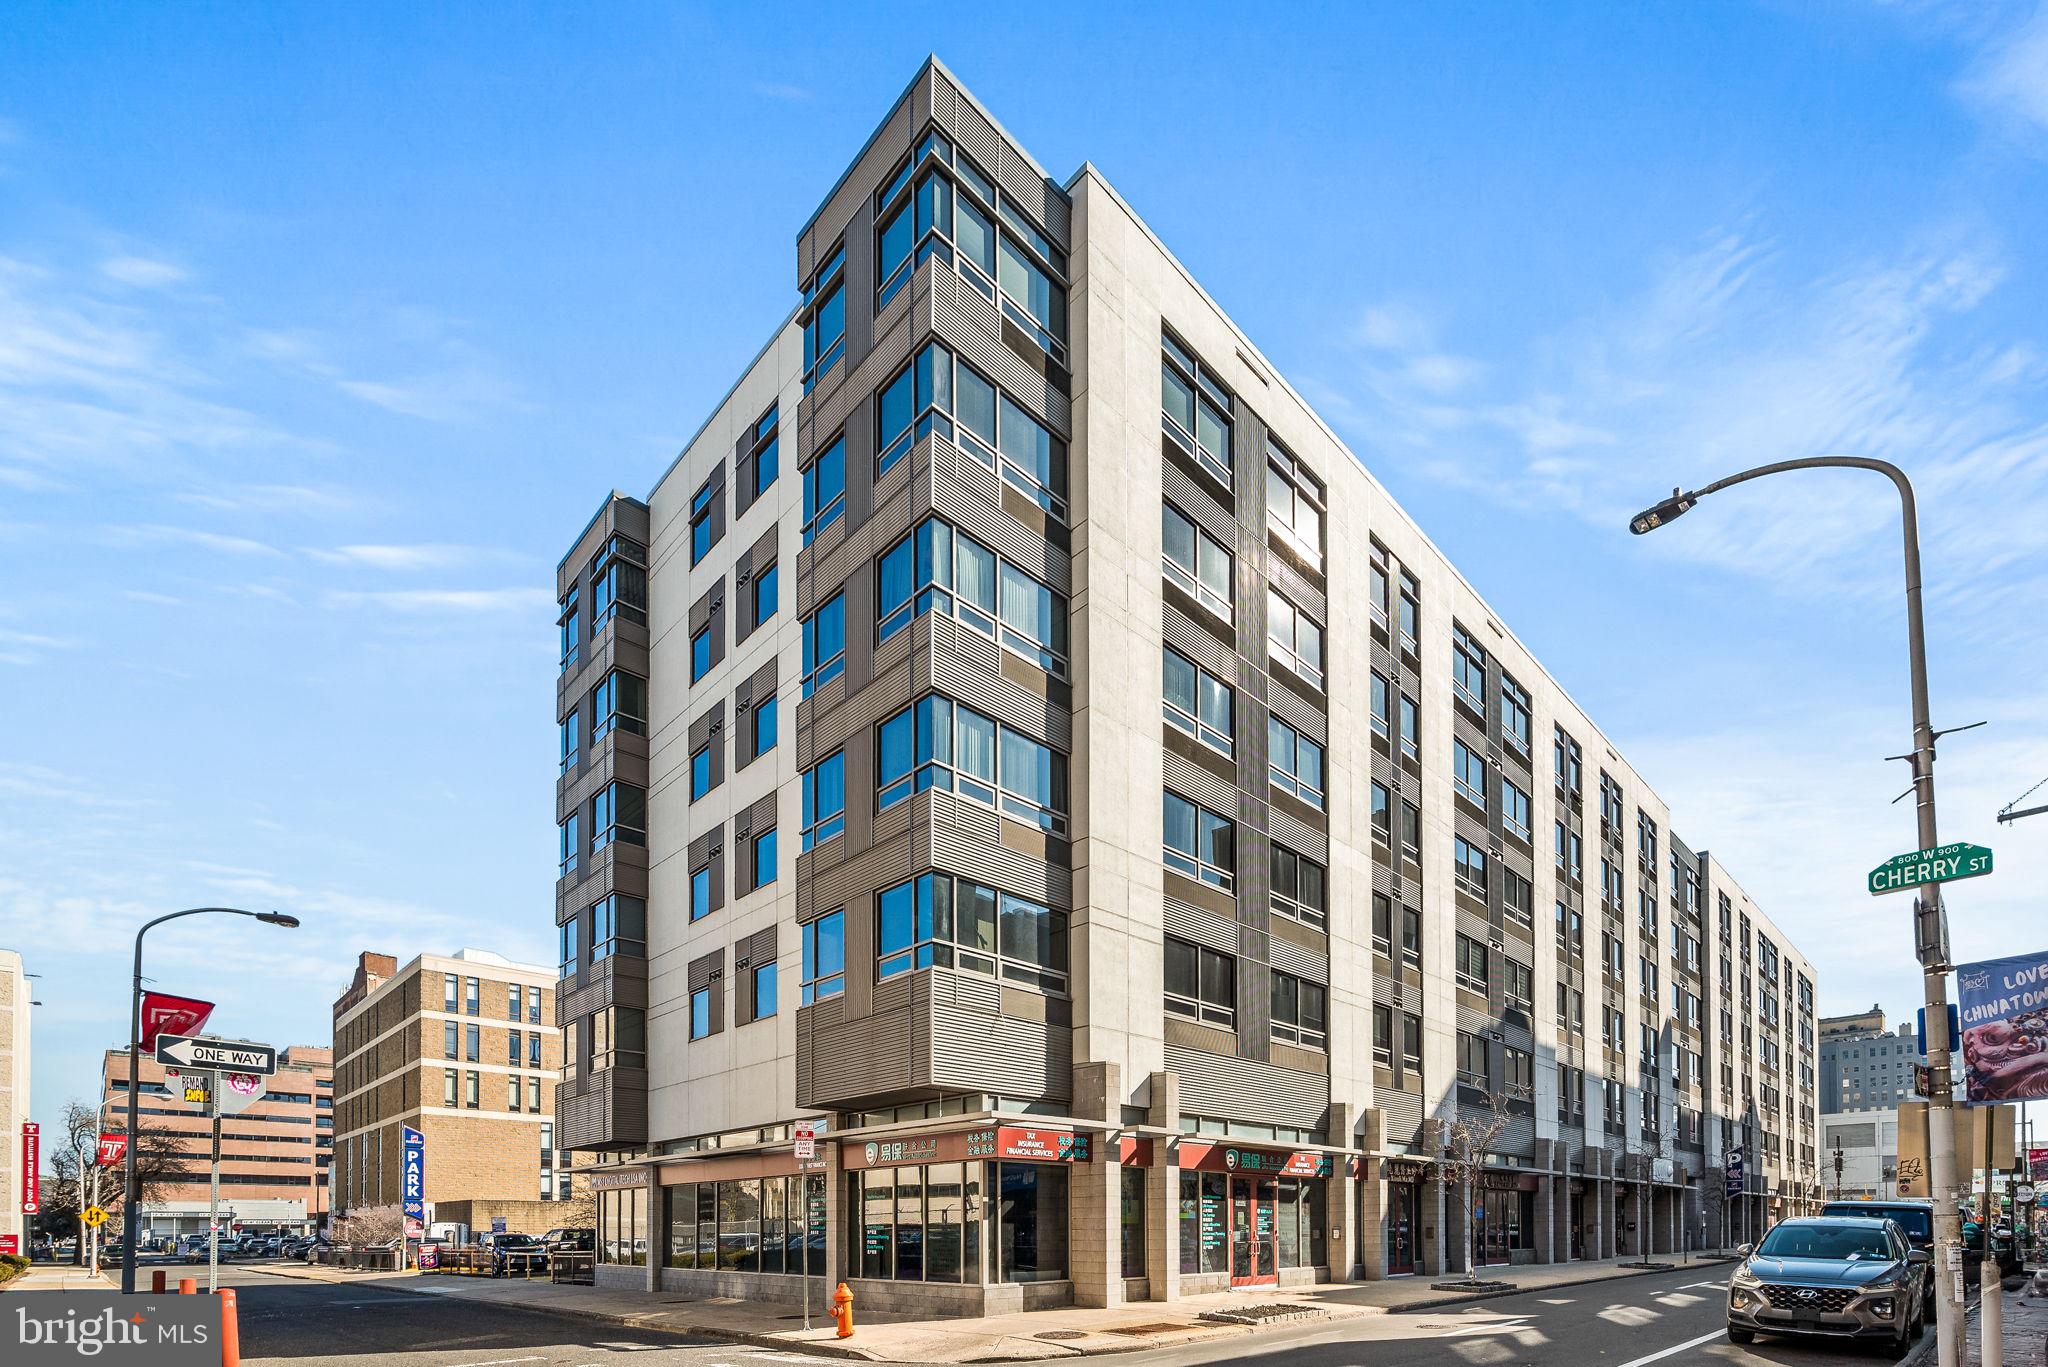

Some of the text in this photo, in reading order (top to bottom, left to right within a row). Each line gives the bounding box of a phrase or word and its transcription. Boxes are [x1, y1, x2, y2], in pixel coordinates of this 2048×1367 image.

[1898, 845, 1959, 864] 800 W 900
[1872, 855, 1988, 890] CHERRY ST
[2003, 963, 2048, 990] LOVE
[193, 1047, 263, 1065] ONE WAY
[881, 1142, 902, 1162] 易保
[1006, 1147, 1054, 1157] FINANCIAL SERVICES
[1017, 1140, 1045, 1149] INSURANCE
[407, 1150, 420, 1197] PARK
